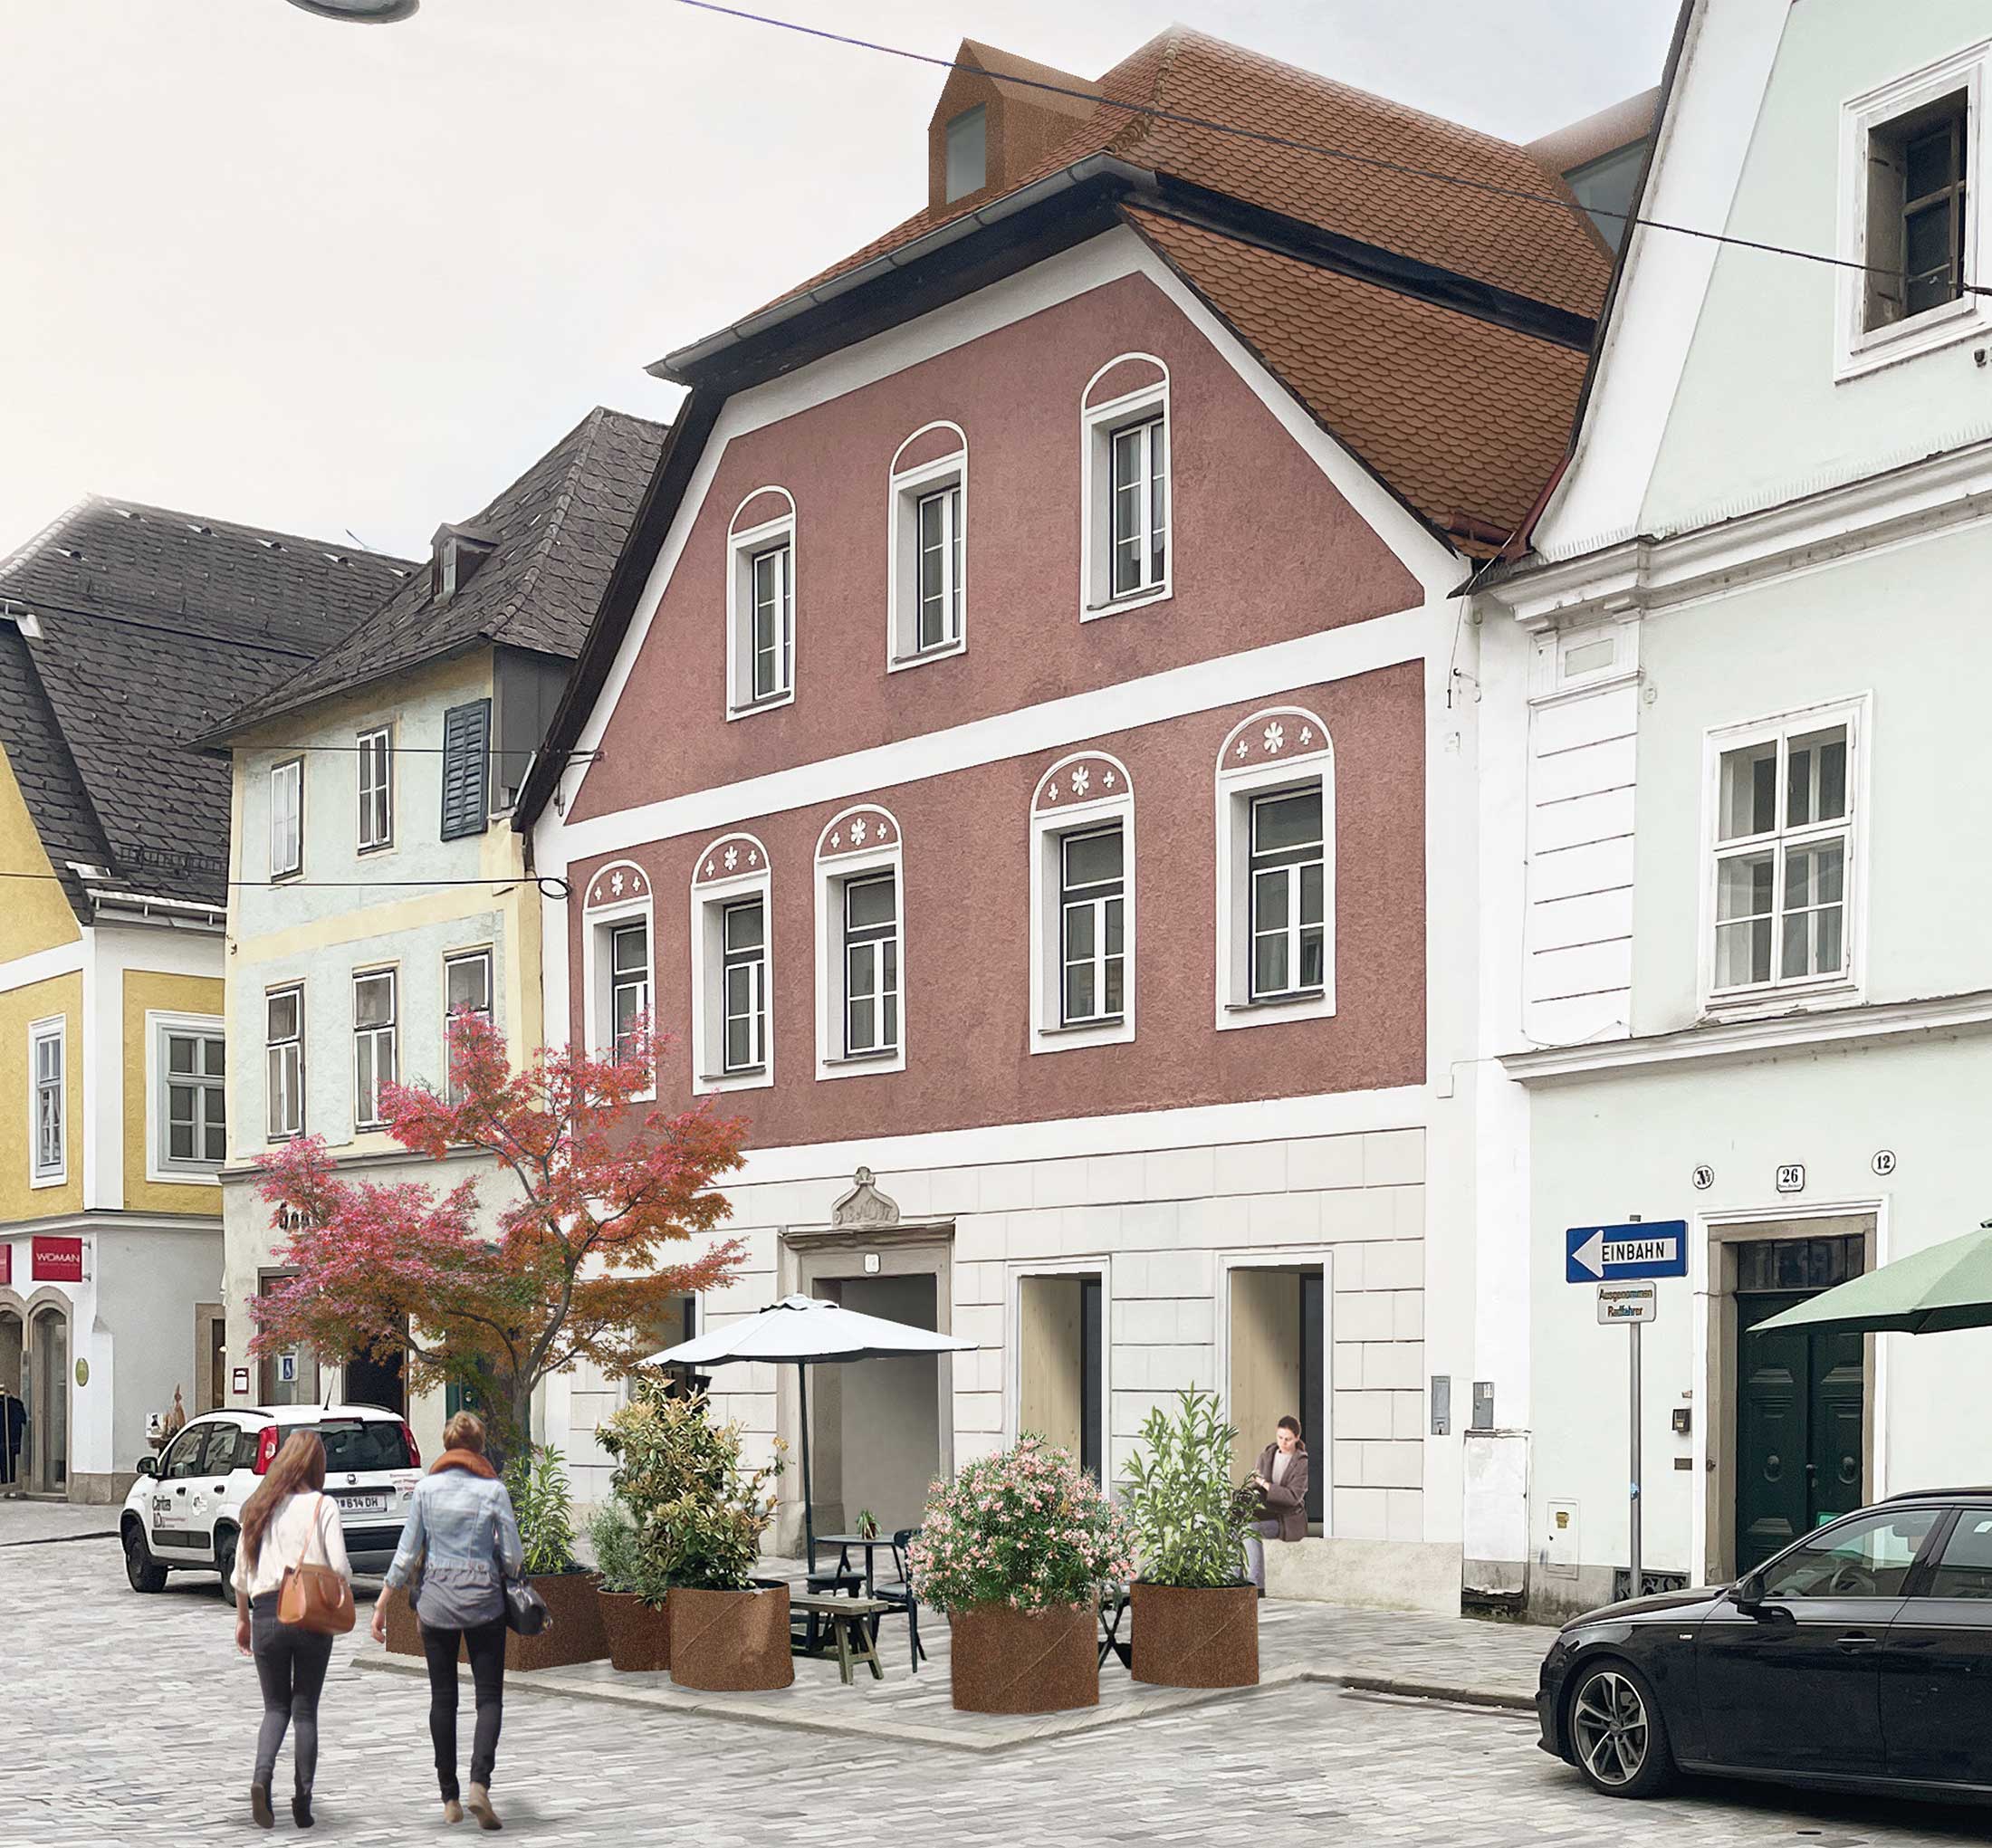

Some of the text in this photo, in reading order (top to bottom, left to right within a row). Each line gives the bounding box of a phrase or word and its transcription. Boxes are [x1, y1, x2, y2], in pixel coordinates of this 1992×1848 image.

[1878, 1154, 1891, 1169] 12
[1782, 1168, 1798, 1183] 26
[36, 1252, 80, 1262] WOMAN
[1602, 1241, 1665, 1261] EINBAHN
[1608, 1305, 1642, 1317] Radfahrer
